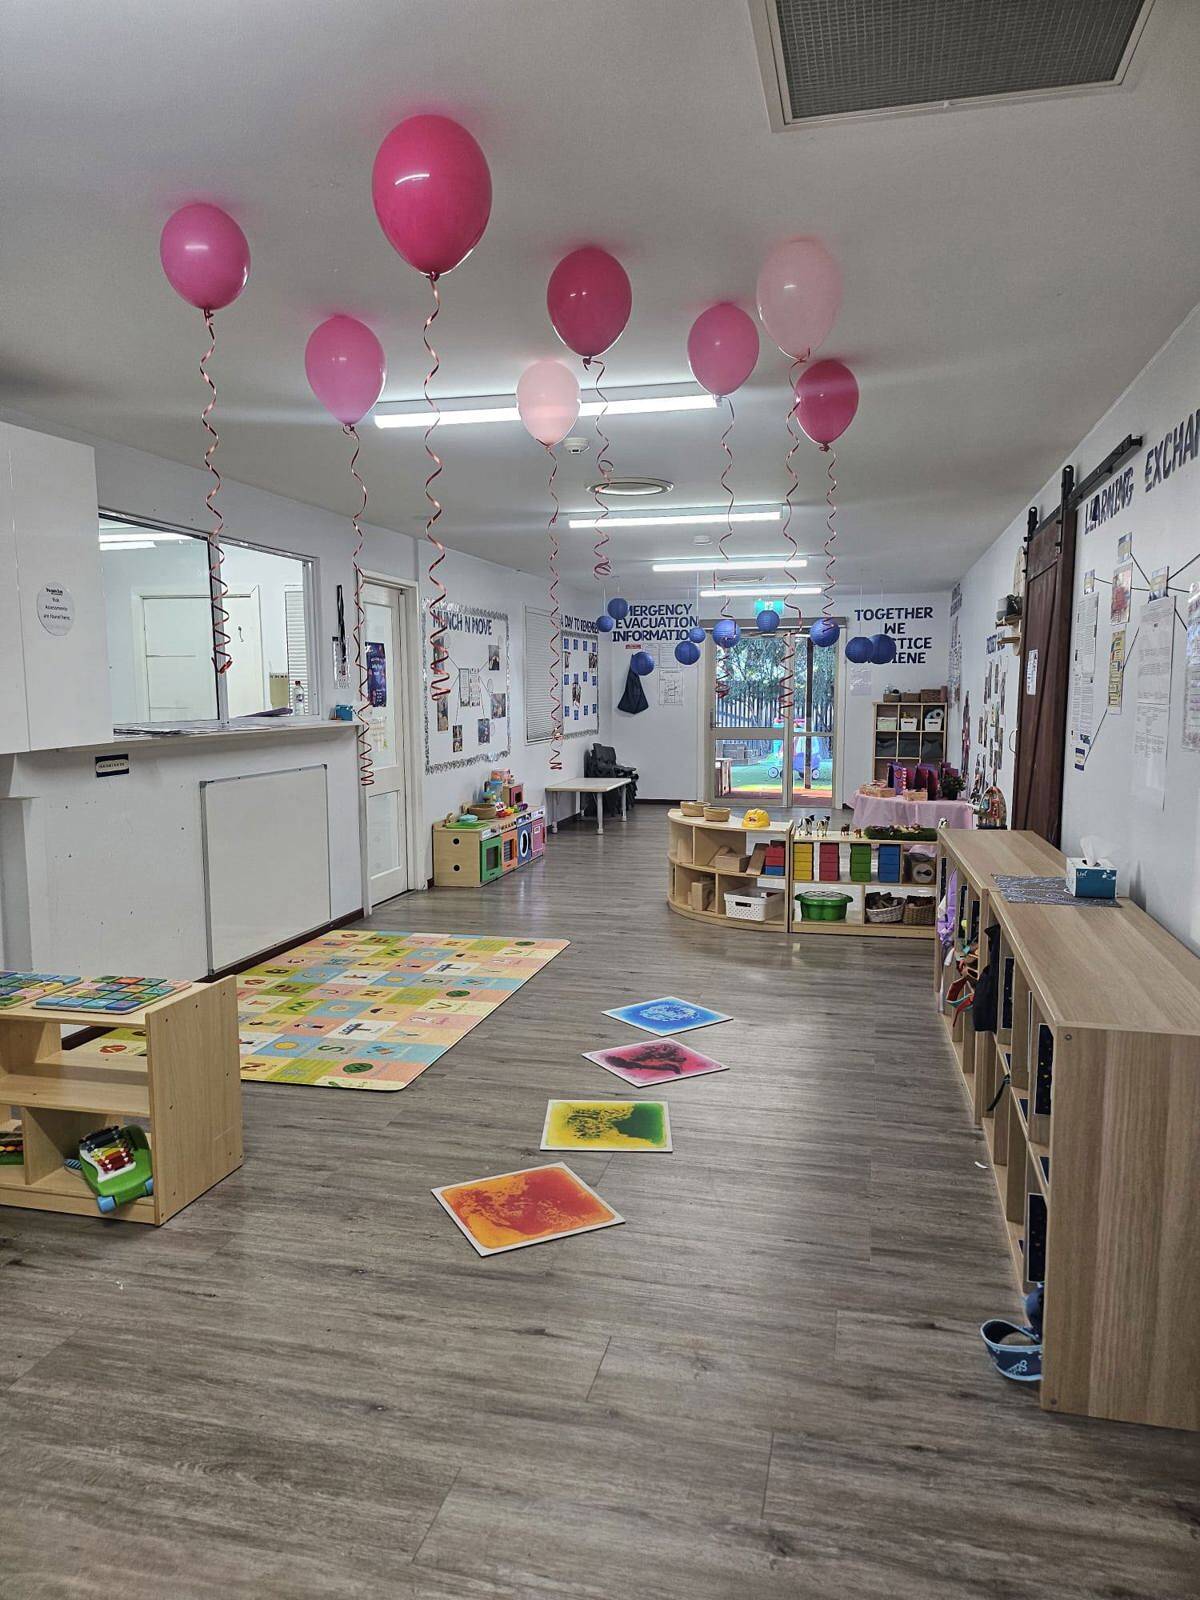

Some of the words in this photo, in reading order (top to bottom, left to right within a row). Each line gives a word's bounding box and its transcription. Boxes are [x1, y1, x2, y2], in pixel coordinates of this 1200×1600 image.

[1084, 466, 1134, 535] LEARNING
[854, 606, 934, 621] TOGETHER
[472, 617, 493, 636] MOVE
[564, 615, 573, 630] DAY
[574, 617, 580, 631] TO
[615, 616, 699, 629] EVACUATION
[884, 622, 906, 635] WE
[612, 630, 689, 642] INFORMATIO
